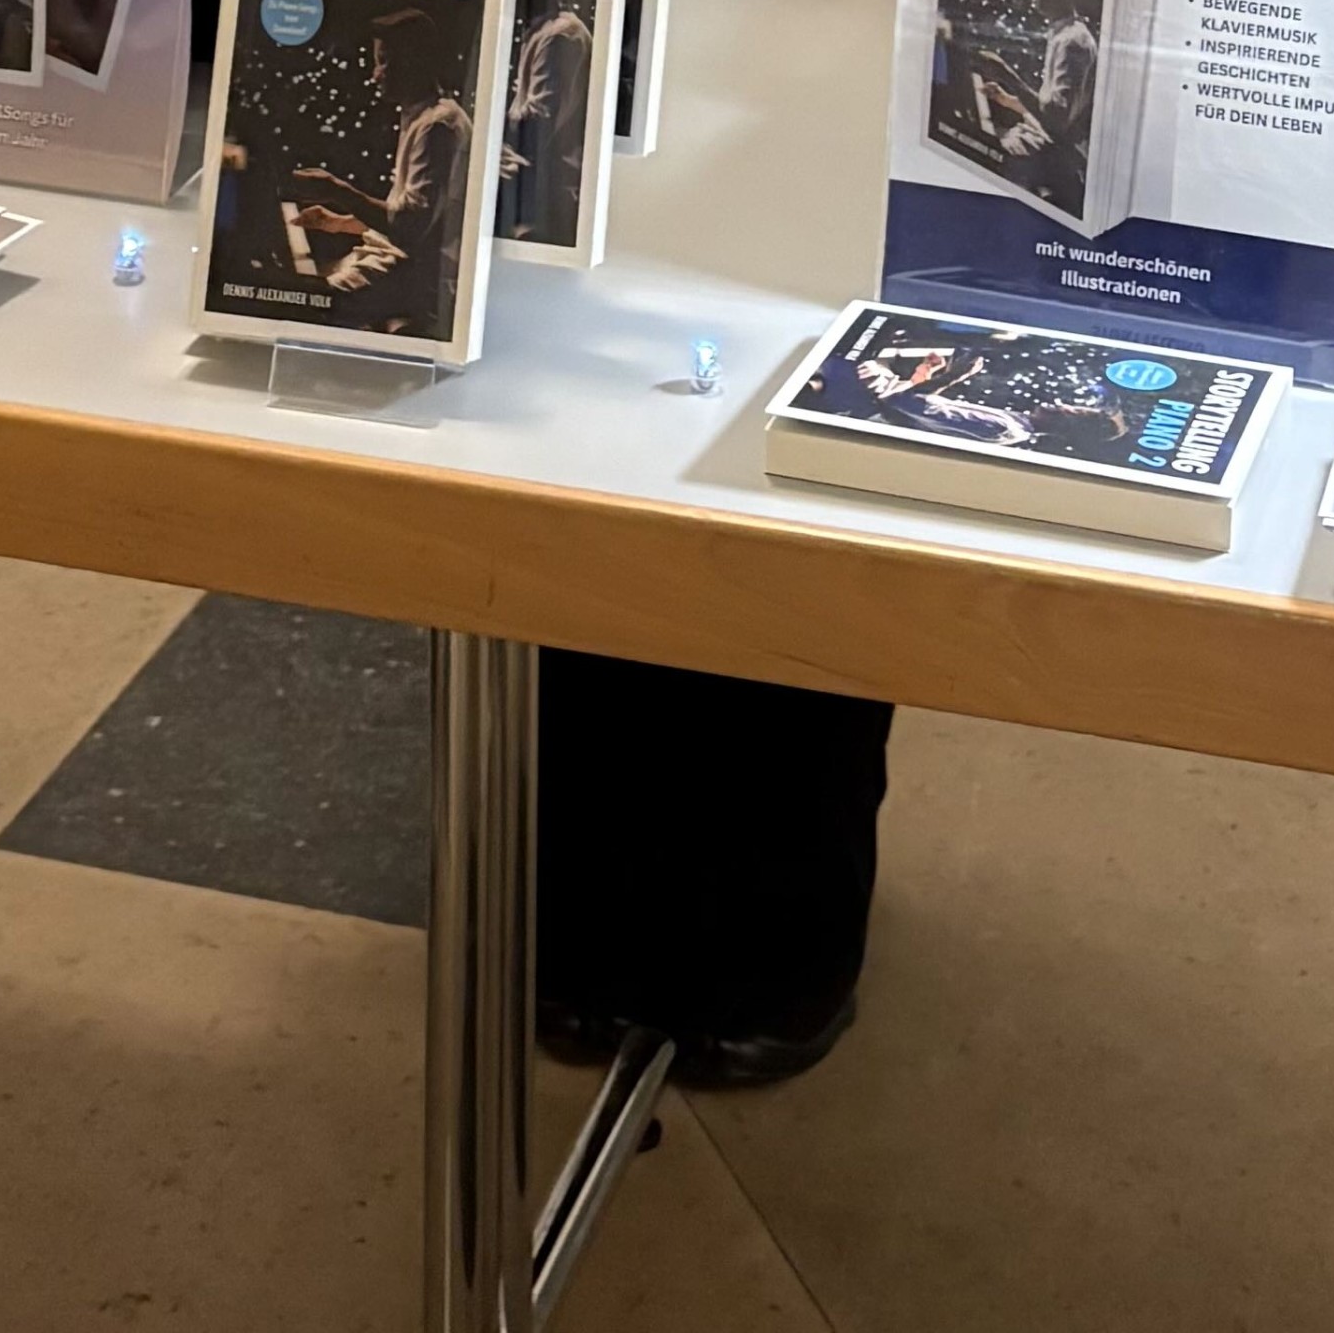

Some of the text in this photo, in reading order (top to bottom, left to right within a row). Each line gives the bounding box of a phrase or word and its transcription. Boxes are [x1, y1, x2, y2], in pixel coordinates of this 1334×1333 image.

[1200, 17, 1318, 46] KLAVIERMUSIK
[1199, 38, 1321, 68] INSPIRIERENDE
[1197, 60, 1311, 89] GESCHICHTEN
[1196, 83, 1291, 109] WERTVOLLE
[51, 111, 74, 128] für
[1195, 103, 1324, 135] FÜR DEIN LEBEN
[1035, 240, 1212, 283] mit wunderschönen
[1060, 270, 1182, 305] Illustrationen
[1137, 398, 1195, 451] PIANO
[1171, 369, 1255, 475] STORYTELLING
[1128, 452, 1168, 468] 2
